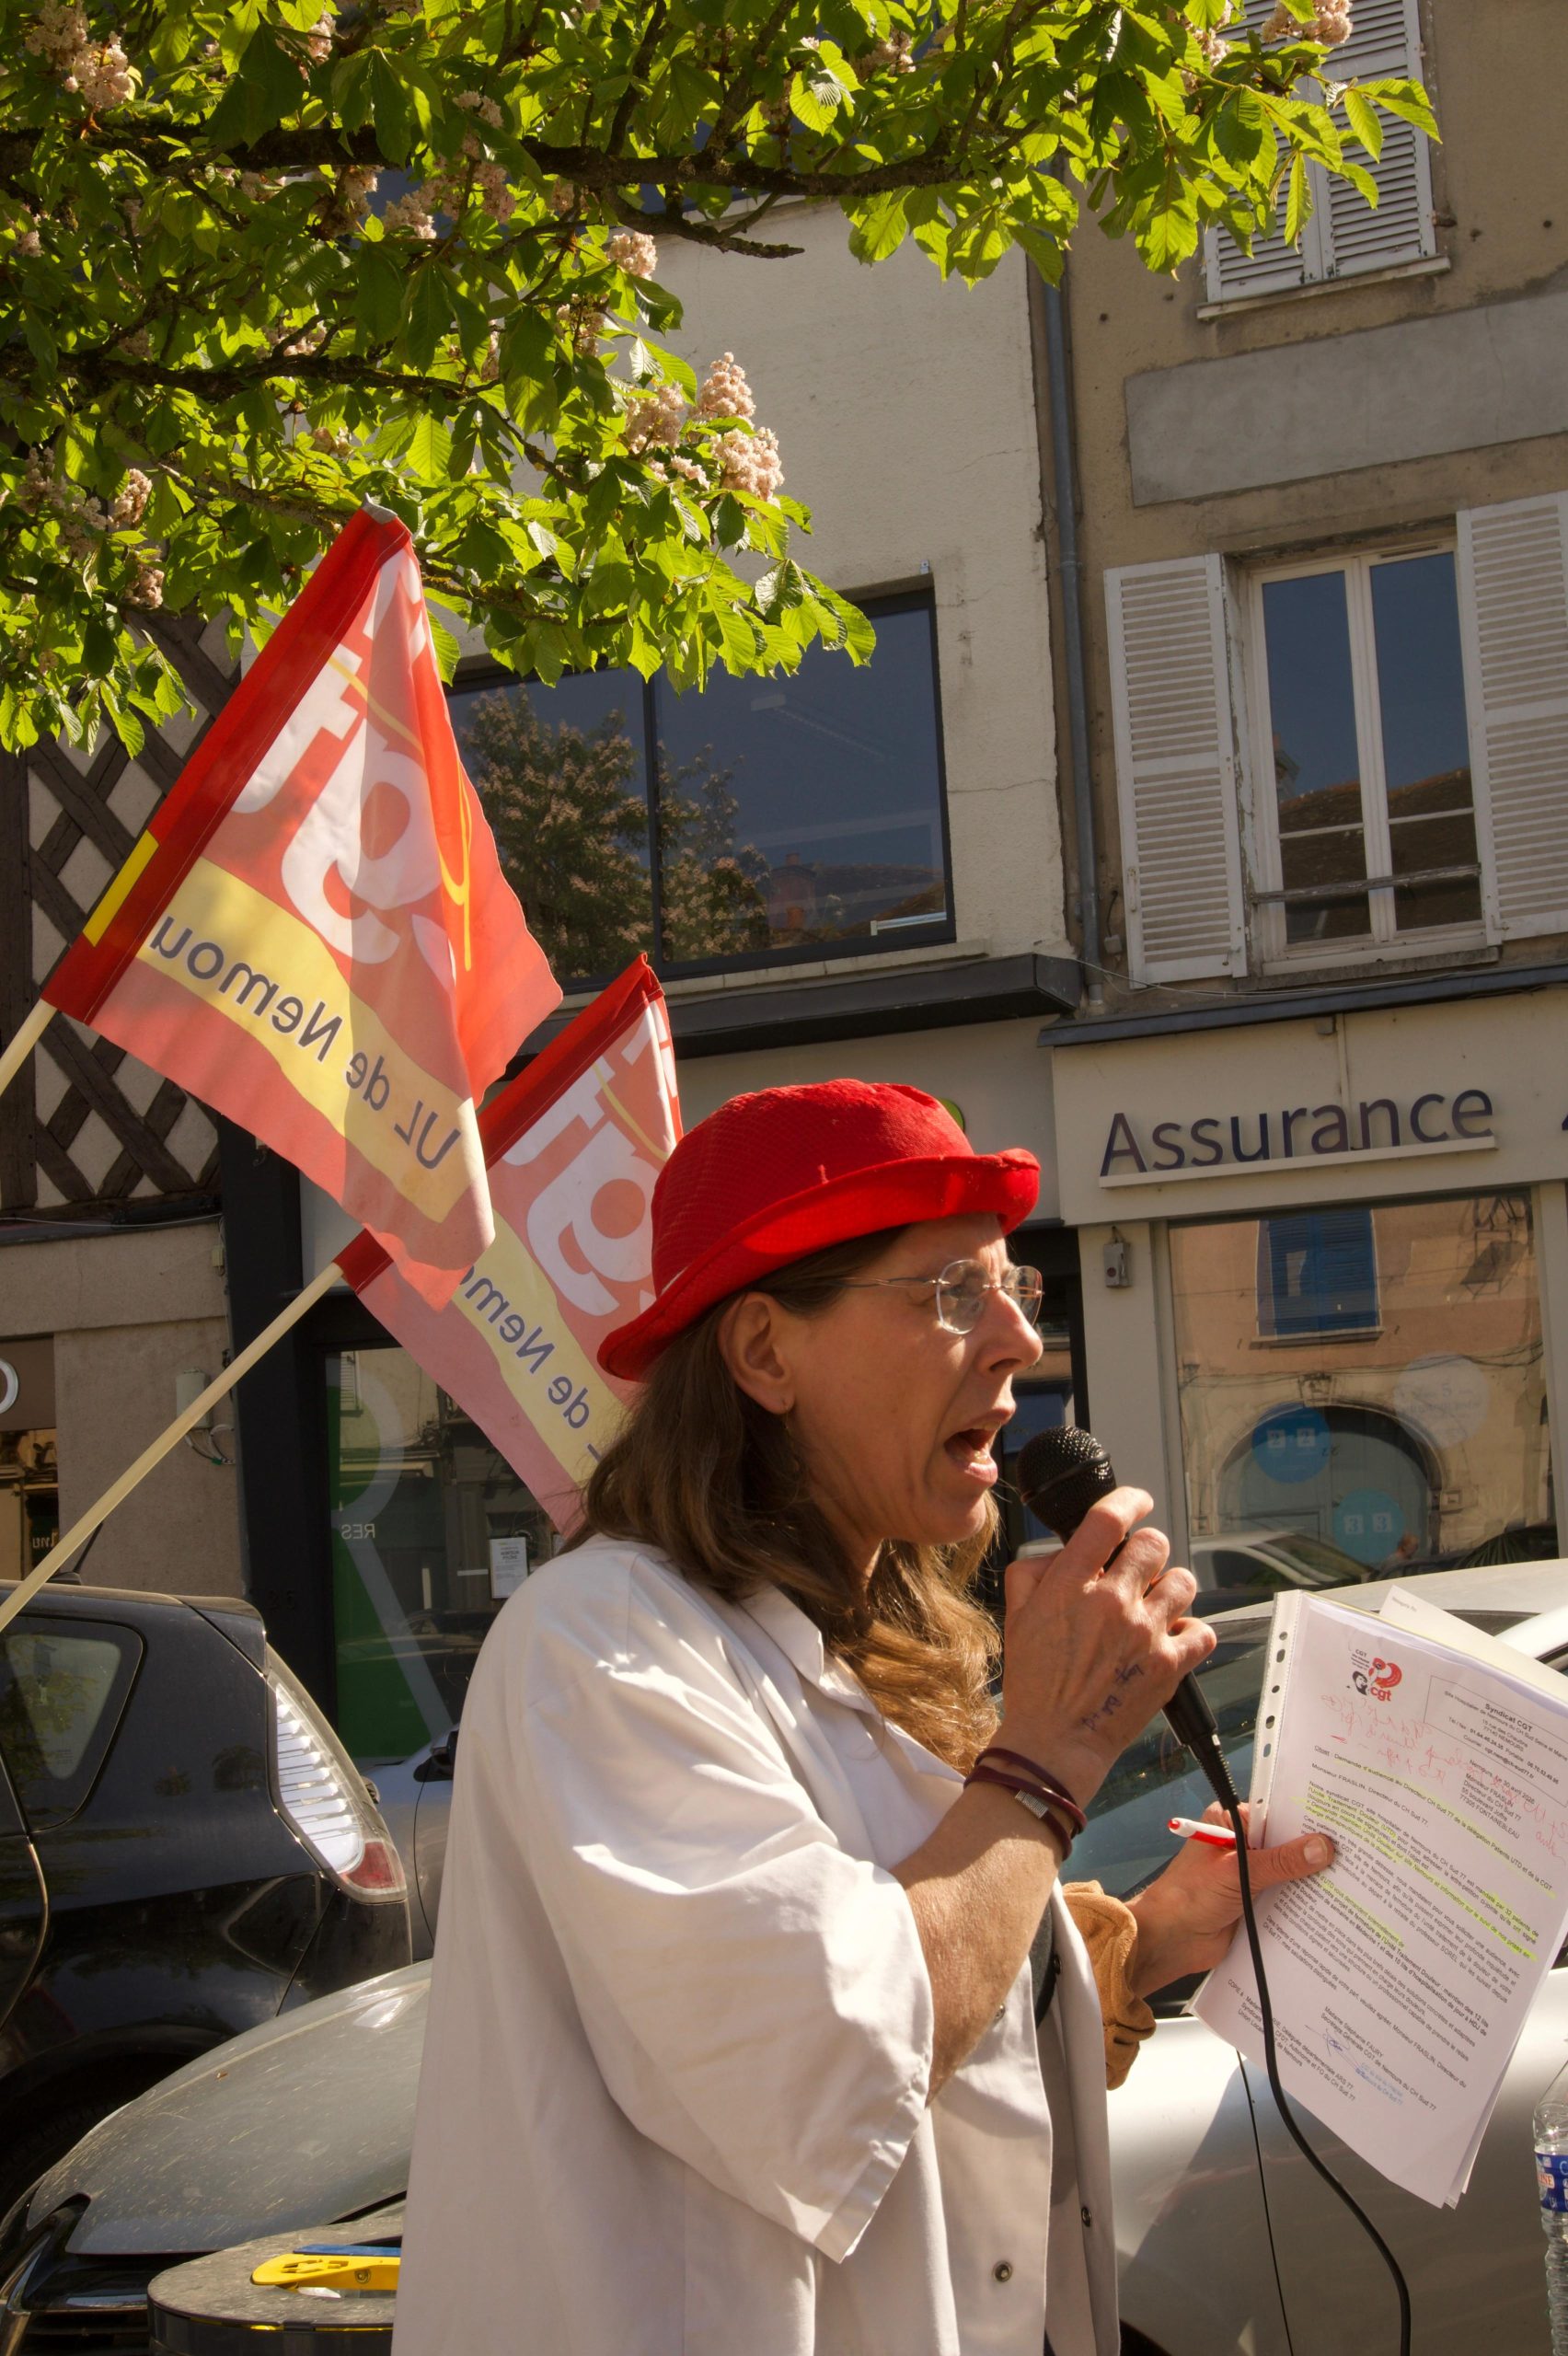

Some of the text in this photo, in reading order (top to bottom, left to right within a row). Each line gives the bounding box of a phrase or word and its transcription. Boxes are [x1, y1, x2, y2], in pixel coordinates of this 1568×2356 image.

[1100, 1089, 1494, 1177] Assurance
[1369, 1682, 1391, 1702] cgt
[1484, 1703, 1532, 1731] Syndicat CGT
[1463, 1779, 1486, 1797] Directeur
[1504, 1806, 1514, 1817] Sud
[1465, 1773, 1513, 1807] Monsieur FRASLIN
[1469, 1792, 1493, 1811] boulevard
[1510, 1785, 1521, 1795] avril
[1410, 1810, 1420, 1820] Sud
[1475, 1805, 1519, 1839] FONTAINEBLEAU
[1435, 1803, 1447, 1813] Sud
[1466, 1825, 1490, 1844] délégation
[1491, 1842, 1509, 1860] Patients
[1510, 1856, 1522, 1868] UTD
[1351, 1799, 1364, 1808] CGT
[1410, 1835, 1431, 1854] Nemours
[1448, 1865, 1458, 1875] Sud
[1466, 1878, 1474, 1887] est
[1495, 1901, 1504, 1910] par
[1512, 1914, 1530, 1931] patients
[1385, 1950, 1393, 1958] des
[1397, 1948, 1420, 1971] Traitement
[1421, 1969, 1440, 1987] Douleur
[1443, 1988, 1463, 2007] maintien
[1464, 2005, 1473, 2015] des
[1324, 2006, 1343, 2024] Madame
[1366, 2041, 1382, 2057] FAURY
[1364, 2049, 1375, 2060] CGT
[1418, 2095, 1428, 2106] Sud
[1436, 2062, 1458, 2082] Directeur
